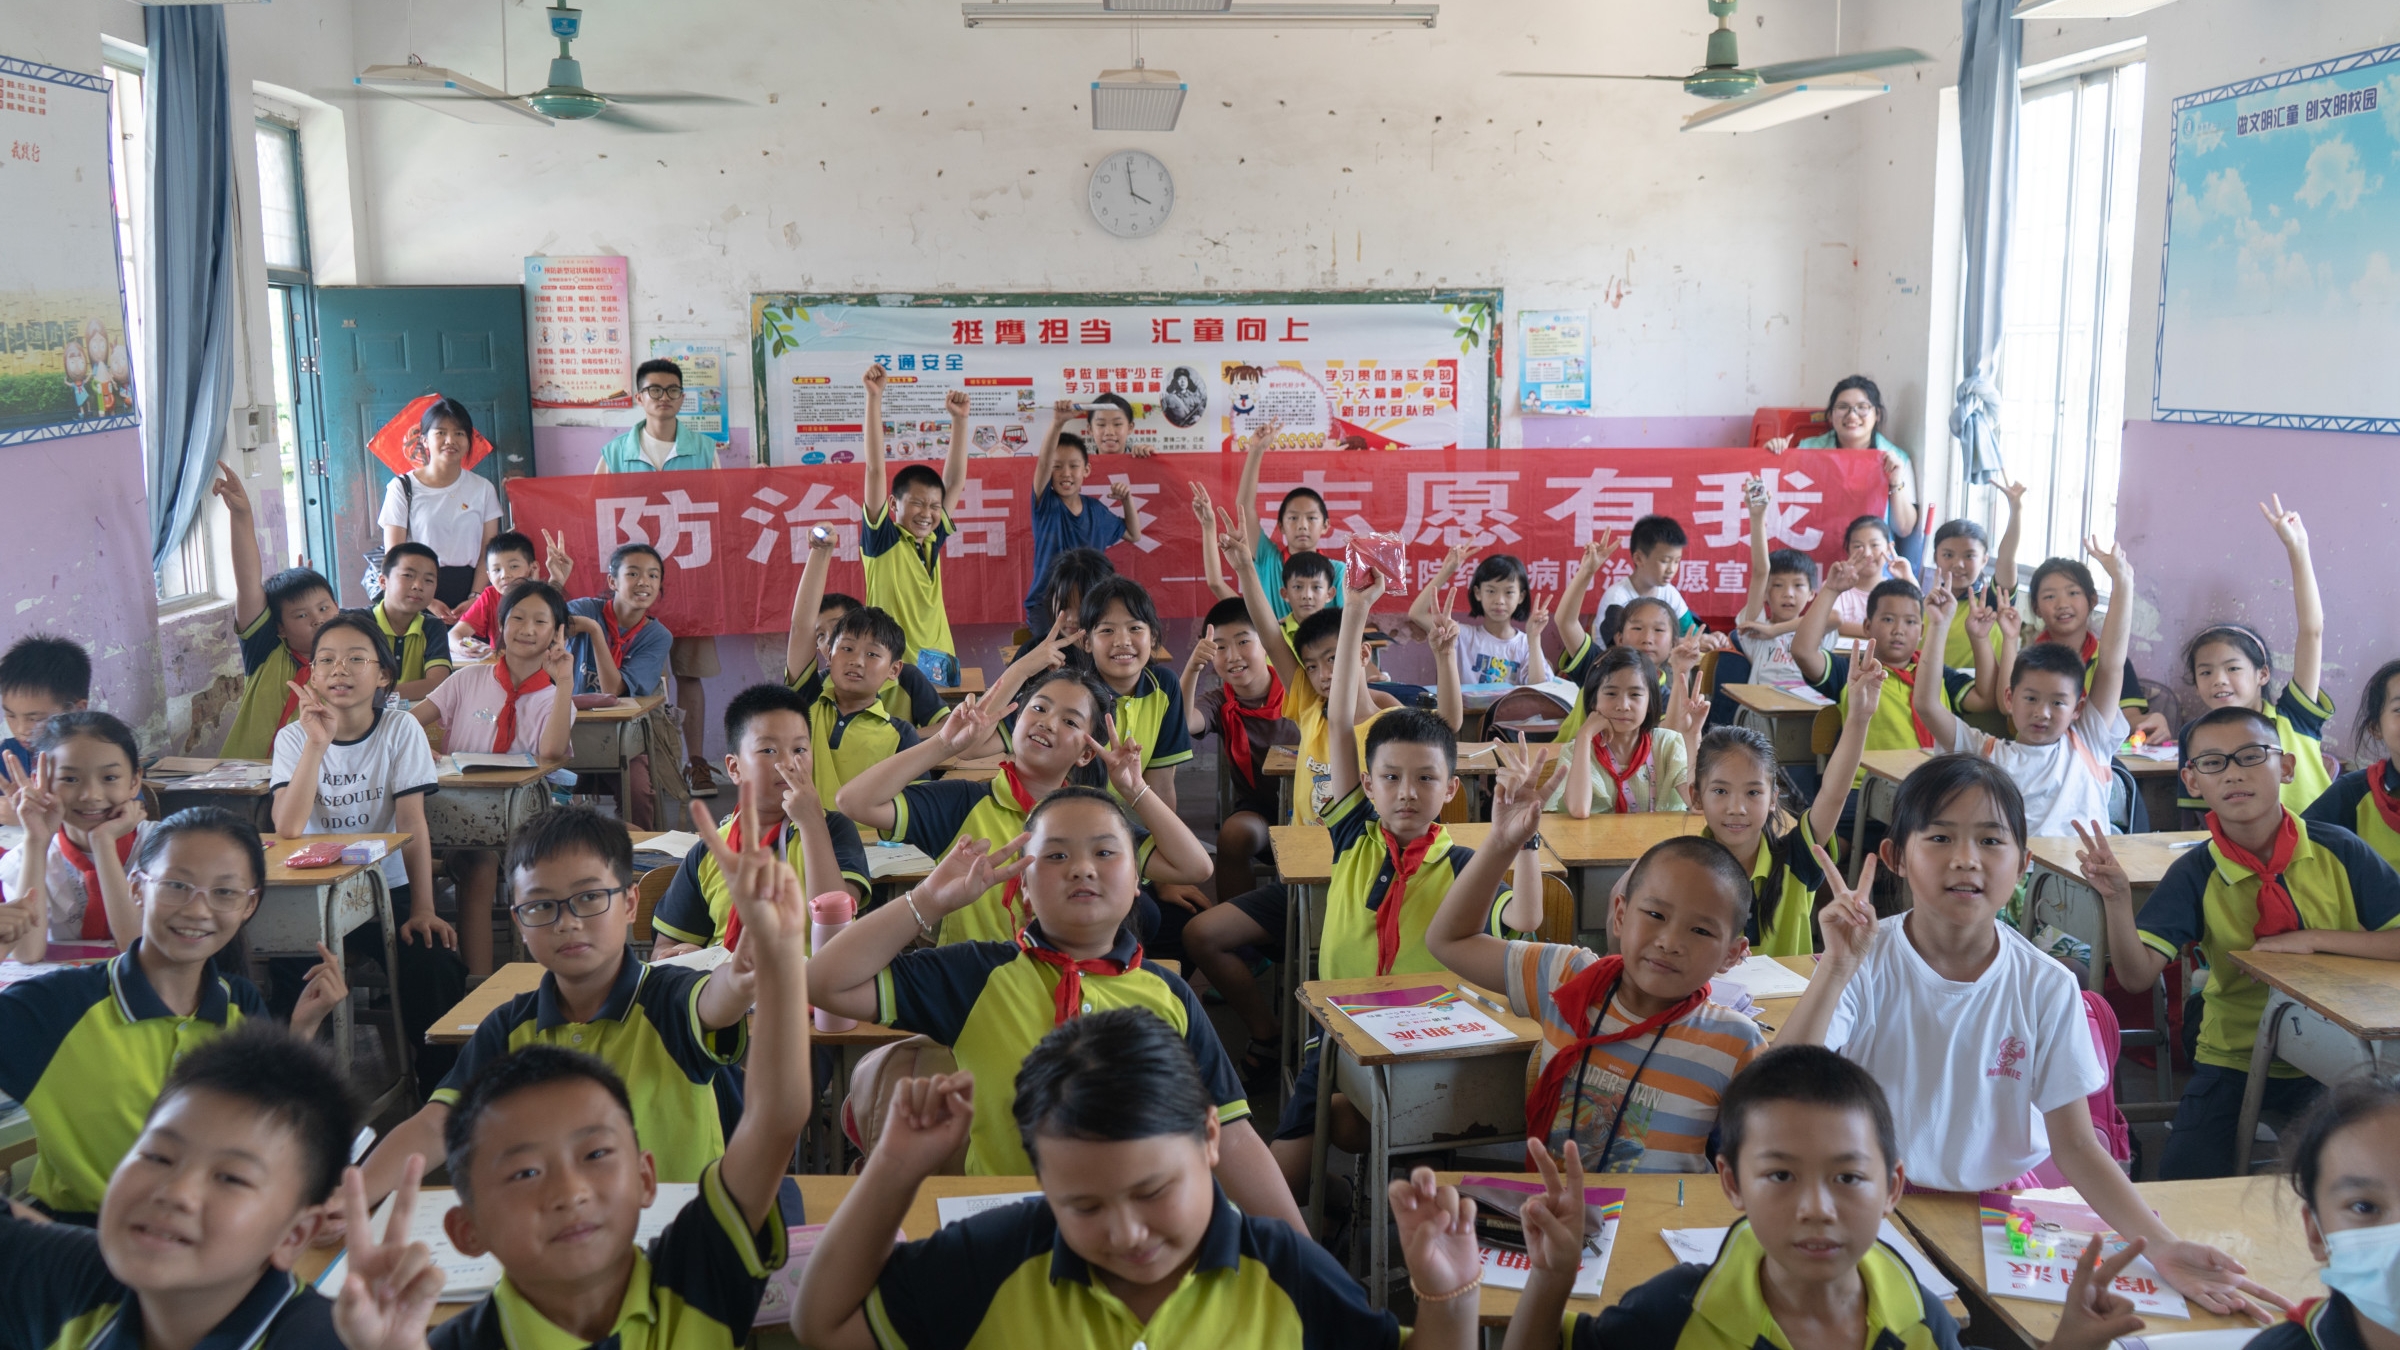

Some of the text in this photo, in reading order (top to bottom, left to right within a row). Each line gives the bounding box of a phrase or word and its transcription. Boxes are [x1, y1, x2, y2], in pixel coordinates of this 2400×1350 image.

[2237, 104, 2299, 136] 做文明汇童
[2305, 87, 2378, 122] 创文明校园
[1151, 317, 1310, 344] 汇童向上
[874, 353, 964, 371] 交通安全
[1325, 369, 1451, 381] 学习贯彻落实党的
[1065, 381, 1161, 394] 学习雷锋精神
[1341, 405, 1435, 417] 新时代好队员
[1255, 467, 1825, 551] 志愿有我
[1306, 755, 1331, 775] PEA
[1386, 1021, 1488, 1041] 假期派
[1986, 1067, 2022, 1081] MINNIE
